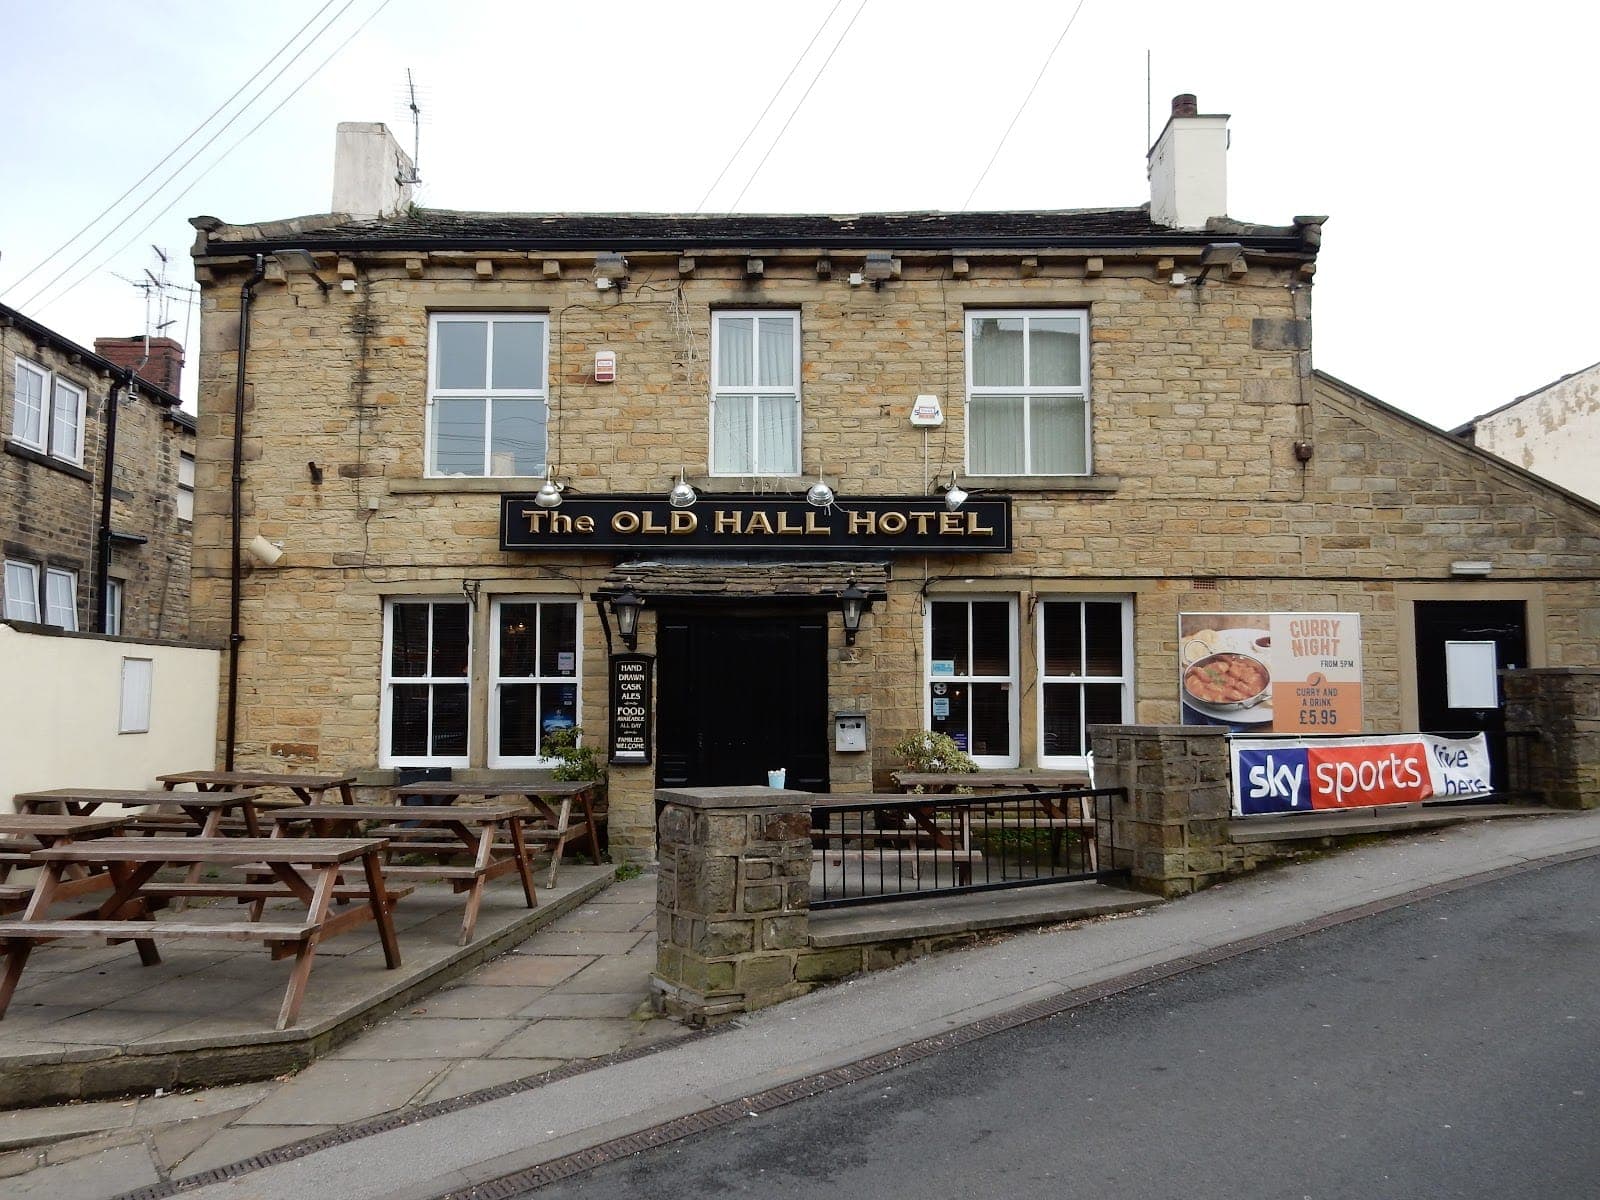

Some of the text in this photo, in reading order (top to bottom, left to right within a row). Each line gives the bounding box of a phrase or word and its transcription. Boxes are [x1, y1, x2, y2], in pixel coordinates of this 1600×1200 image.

[522, 509, 993, 536] The OLD HALL HOTEL
[1289, 618, 1341, 638] CURRY
[1291, 638, 1341, 657] NIGHT
[620, 664, 642, 672] HAND
[1340, 660, 1354, 668] 5PM
[618, 673, 645, 681] DRAWN
[620, 683, 642, 691] CASK
[621, 692, 641, 700] ALES
[1296, 688, 1338, 696] CURRY AND
[1309, 698, 1332, 707] DRINK
[617, 706, 645, 716] FOOD
[1299, 709, 1337, 725] £5.95
[616, 742, 645, 750] WELCOME
[1433, 743, 1469, 769] live
[1249, 753, 1422, 807] sky sports
[1443, 772, 1487, 796] here
